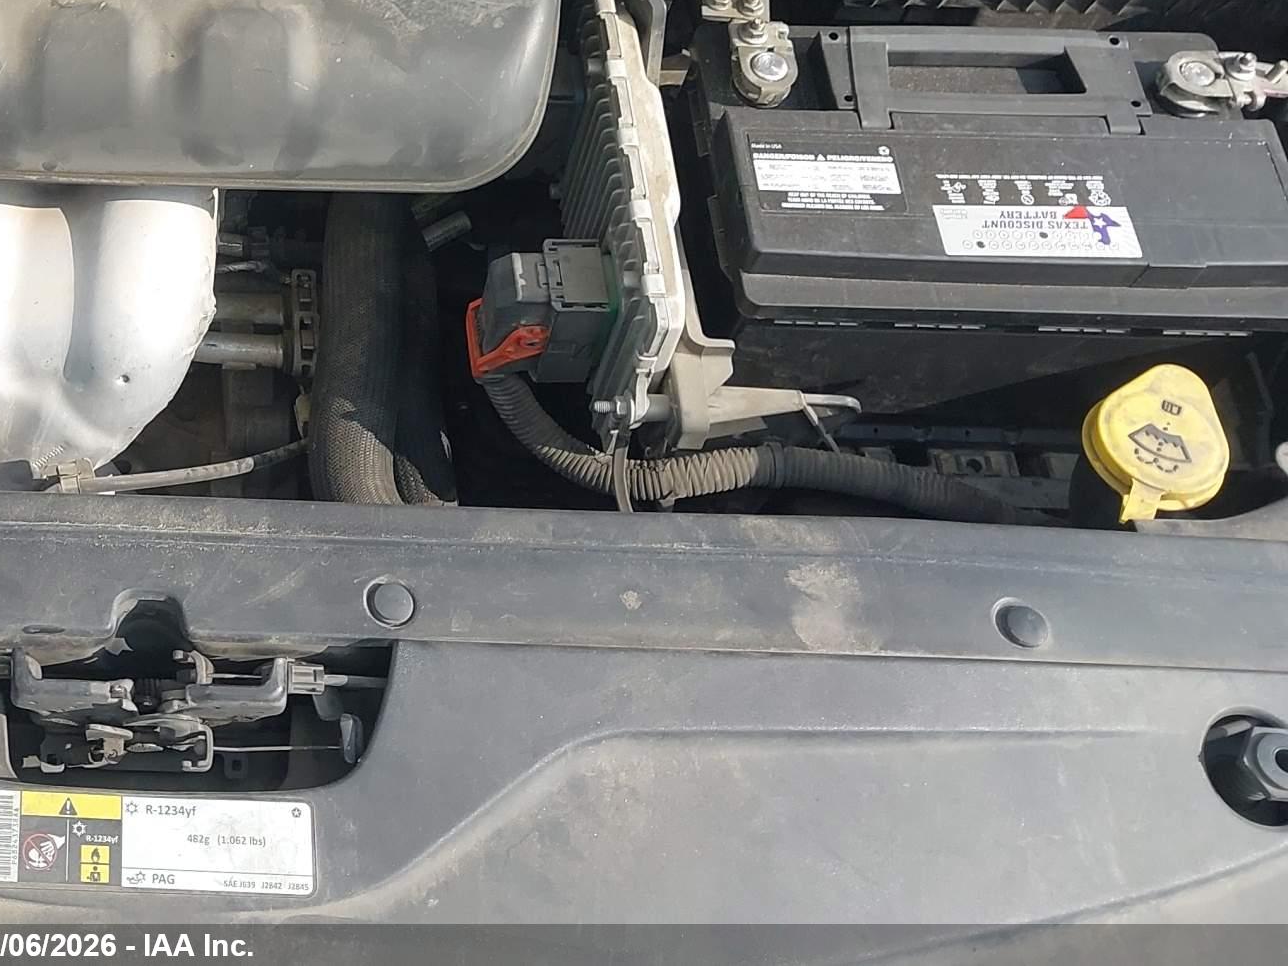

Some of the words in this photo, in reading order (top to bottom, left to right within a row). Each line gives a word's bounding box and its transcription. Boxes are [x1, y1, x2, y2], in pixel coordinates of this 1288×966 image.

[999, 210, 1057, 220] BATTERY
[982, 219, 1043, 230] DISCOUNT
[1047, 220, 1088, 230] TEXAS
[145, 804, 197, 818] R-1234yf
[85, 834, 119, 845] R-1234yf
[187, 834, 210, 846] 482g
[217, 835, 247, 846] (1.062
[249, 836, 266, 847] lbs)
[151, 873, 175, 885] PAG
